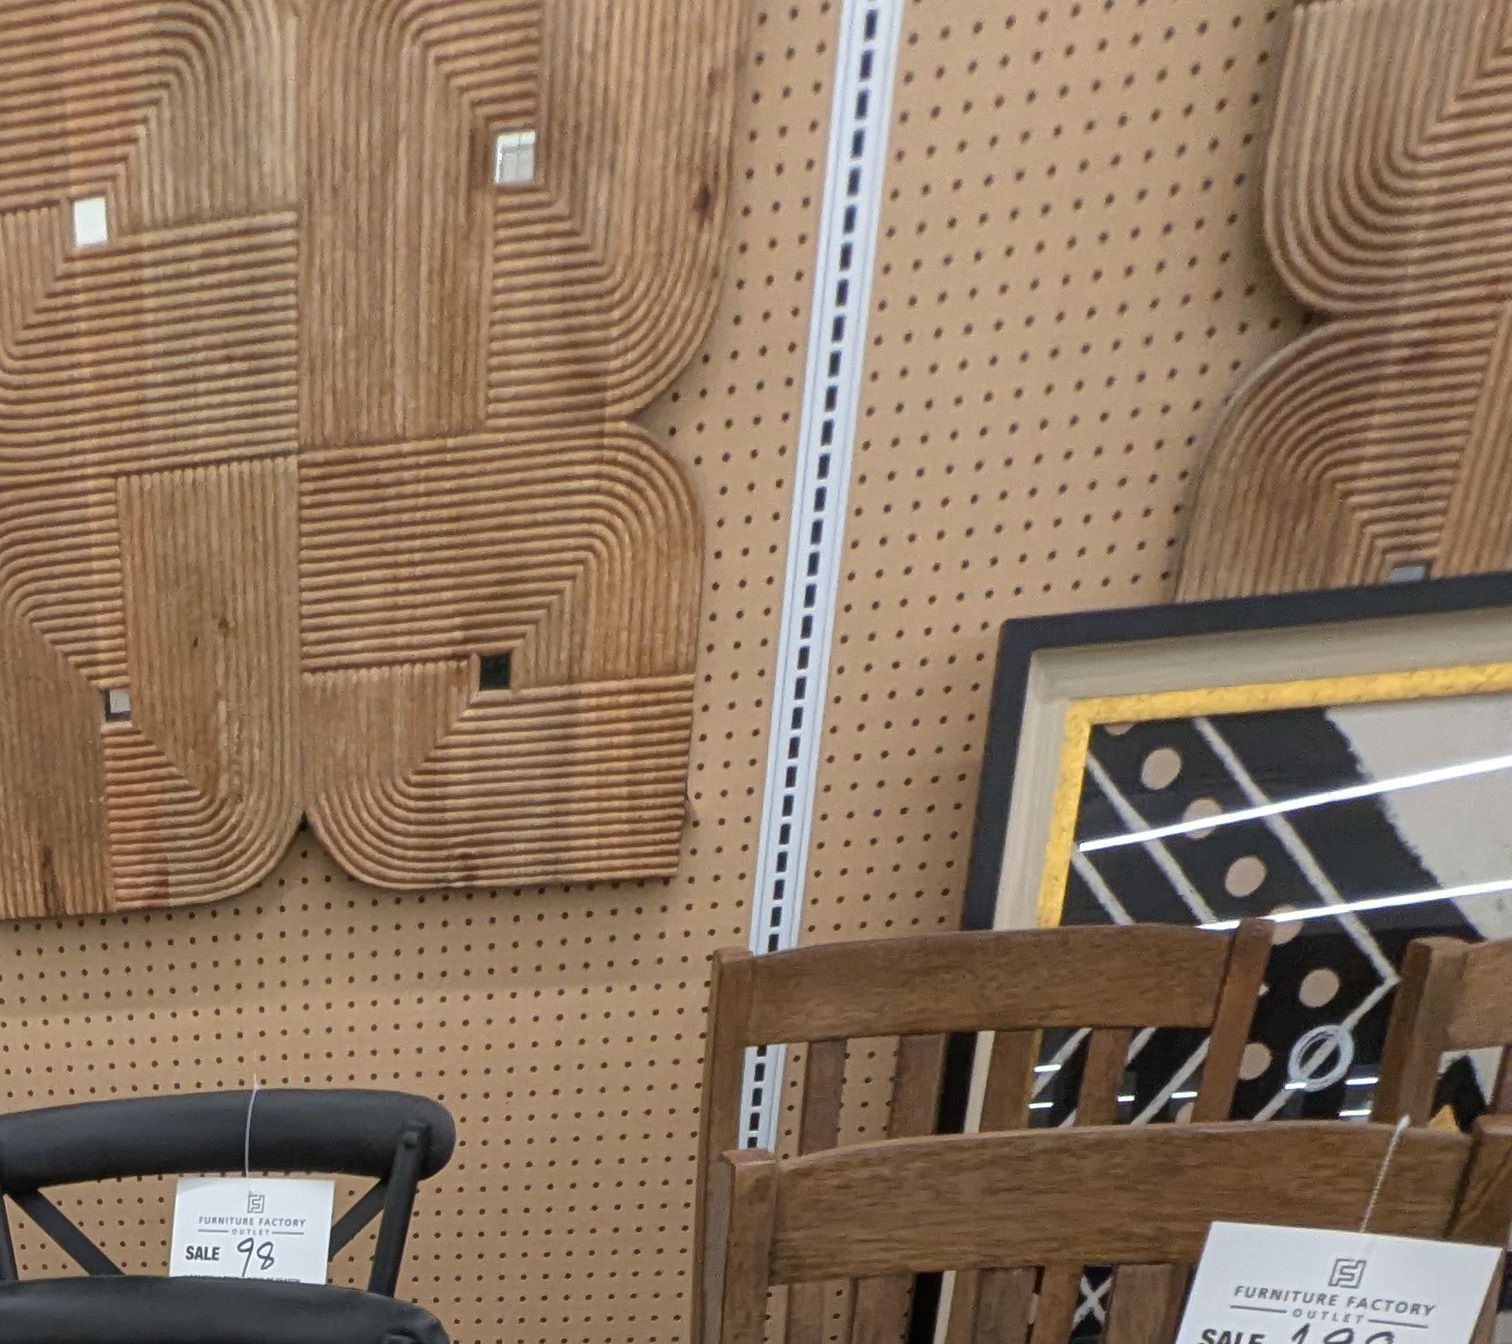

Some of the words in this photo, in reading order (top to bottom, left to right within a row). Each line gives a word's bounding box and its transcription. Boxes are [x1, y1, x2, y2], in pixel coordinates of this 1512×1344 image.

[199, 1216, 254, 1226] FURNITURE
[258, 1218, 306, 1227] FACTORY
[231, 1228, 270, 1236] OUTLET
[185, 1245, 220, 1261] SALE
[237, 1237, 275, 1278] 98
[1234, 1285, 1337, 1306] FURNITURE
[1347, 1296, 1436, 1317] FACTORY
[1292, 1308, 1365, 1324] OUTLET
